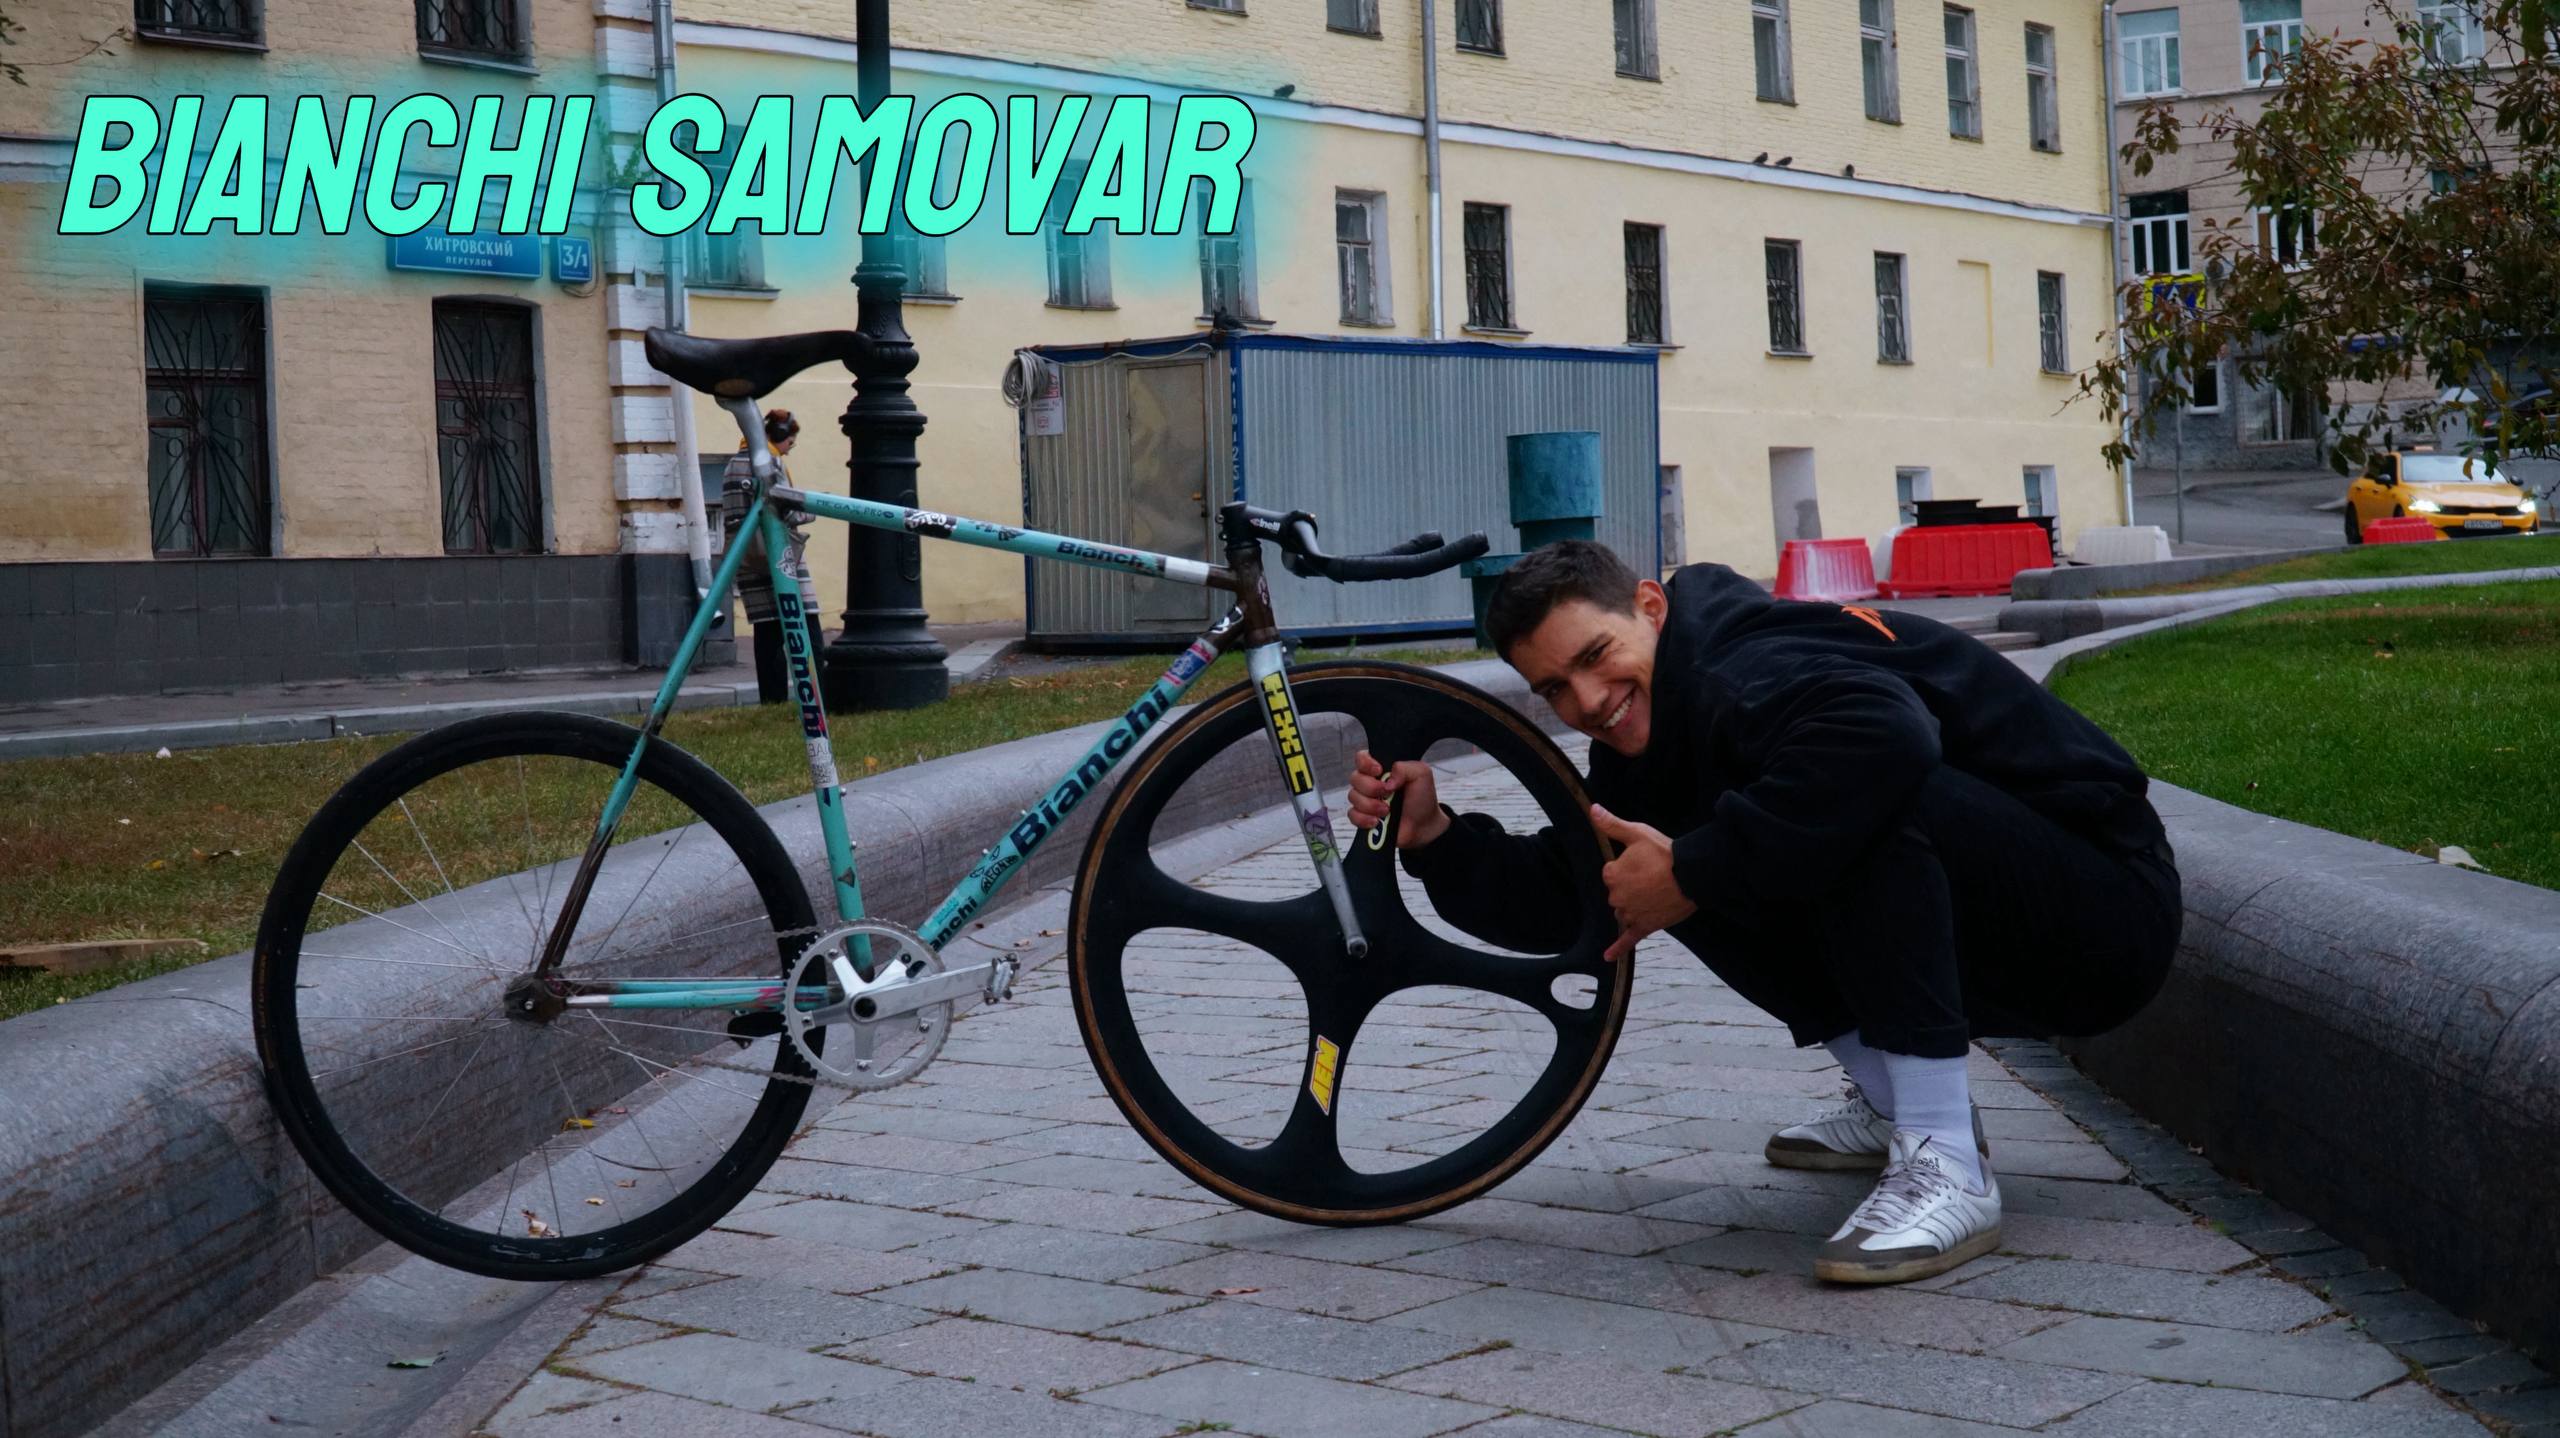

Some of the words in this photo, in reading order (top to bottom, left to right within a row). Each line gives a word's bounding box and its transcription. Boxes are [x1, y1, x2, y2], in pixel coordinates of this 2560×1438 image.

[425, 236, 513, 257] ХИТРОВСКИЙ
[562, 244, 588, 269] 3/1
[445, 256, 493, 267] ПЕРЕУЛОК
[1056, 541, 1146, 569] Bianch
[778, 593, 822, 738] Bianch
[1010, 685, 1170, 858] Bianchi
[929, 895, 978, 953] anchi
